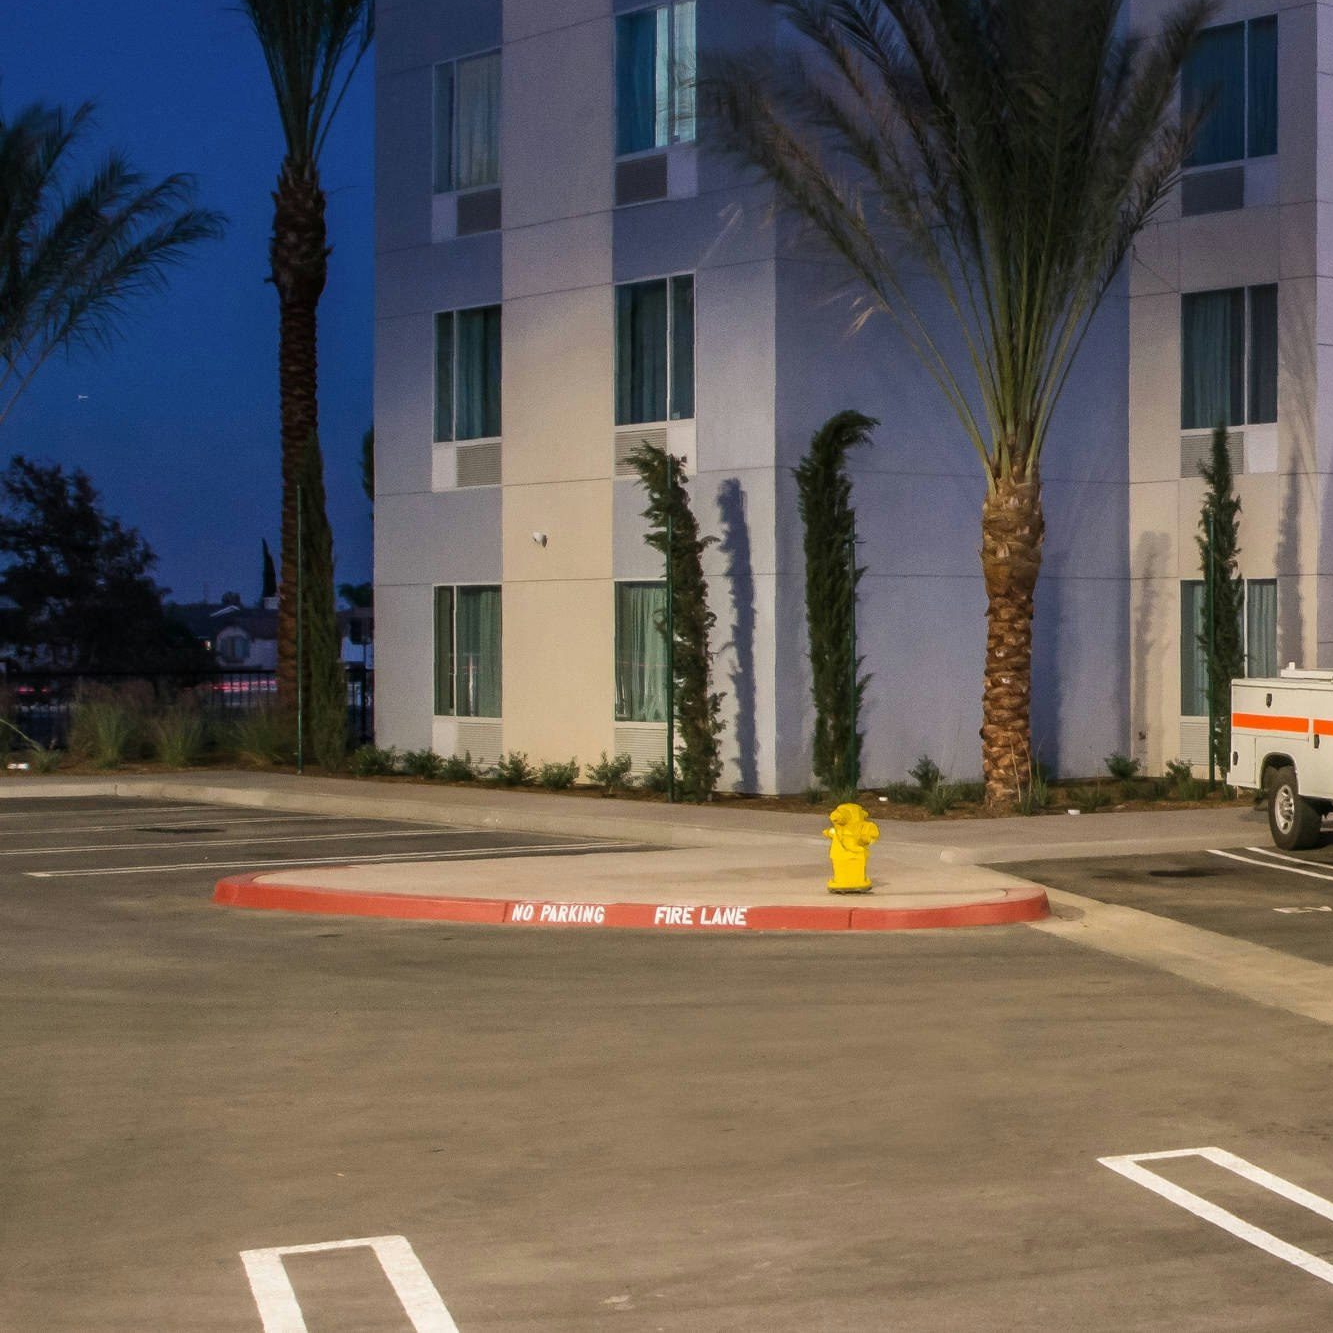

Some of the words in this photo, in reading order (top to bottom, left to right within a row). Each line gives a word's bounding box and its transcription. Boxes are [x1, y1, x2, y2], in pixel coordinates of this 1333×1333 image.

[511, 904, 533, 922] NO
[540, 905, 605, 924] PARKING
[654, 906, 694, 925] FIRE
[699, 906, 748, 926] LANE
